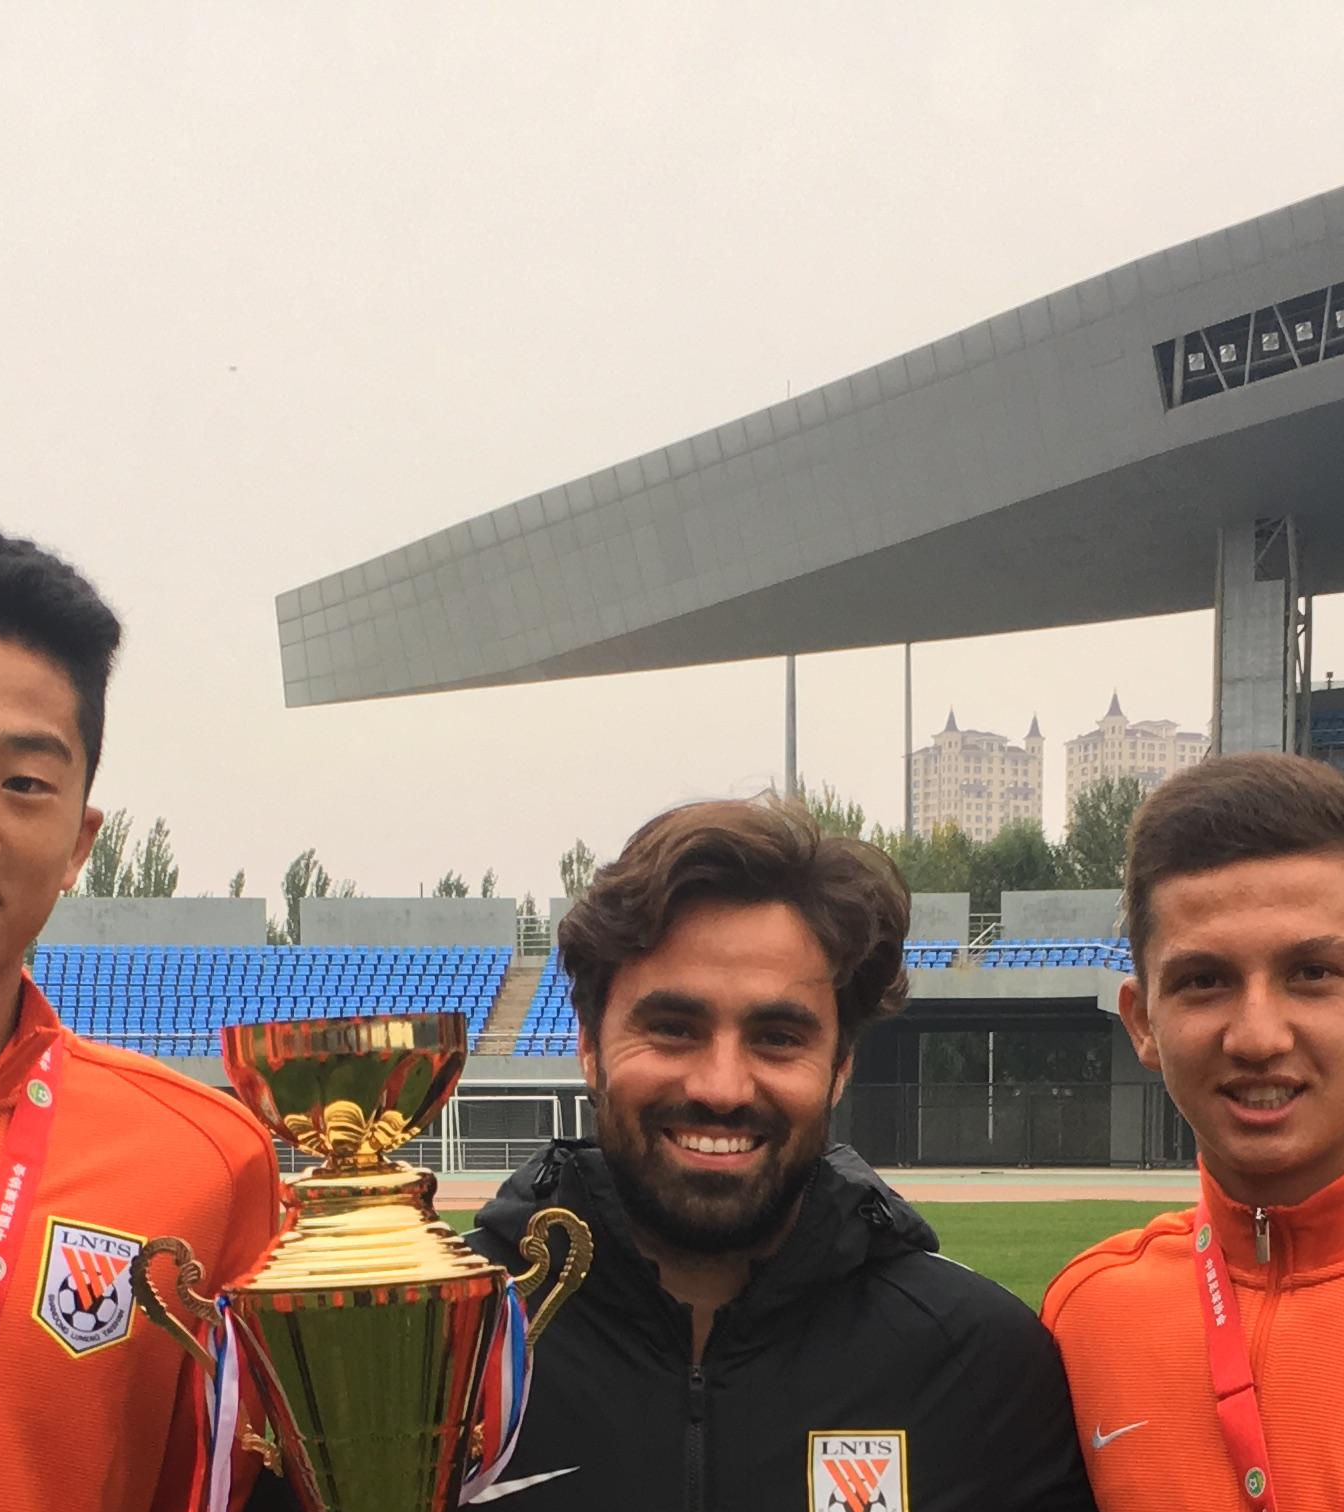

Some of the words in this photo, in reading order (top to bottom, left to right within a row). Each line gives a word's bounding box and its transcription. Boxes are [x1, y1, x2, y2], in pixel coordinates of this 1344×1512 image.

[61, 1230, 132, 1258] LNTS
[1204, 1258, 1227, 1327] 中国足球协会
[820, 1440, 893, 1456] LNTS
